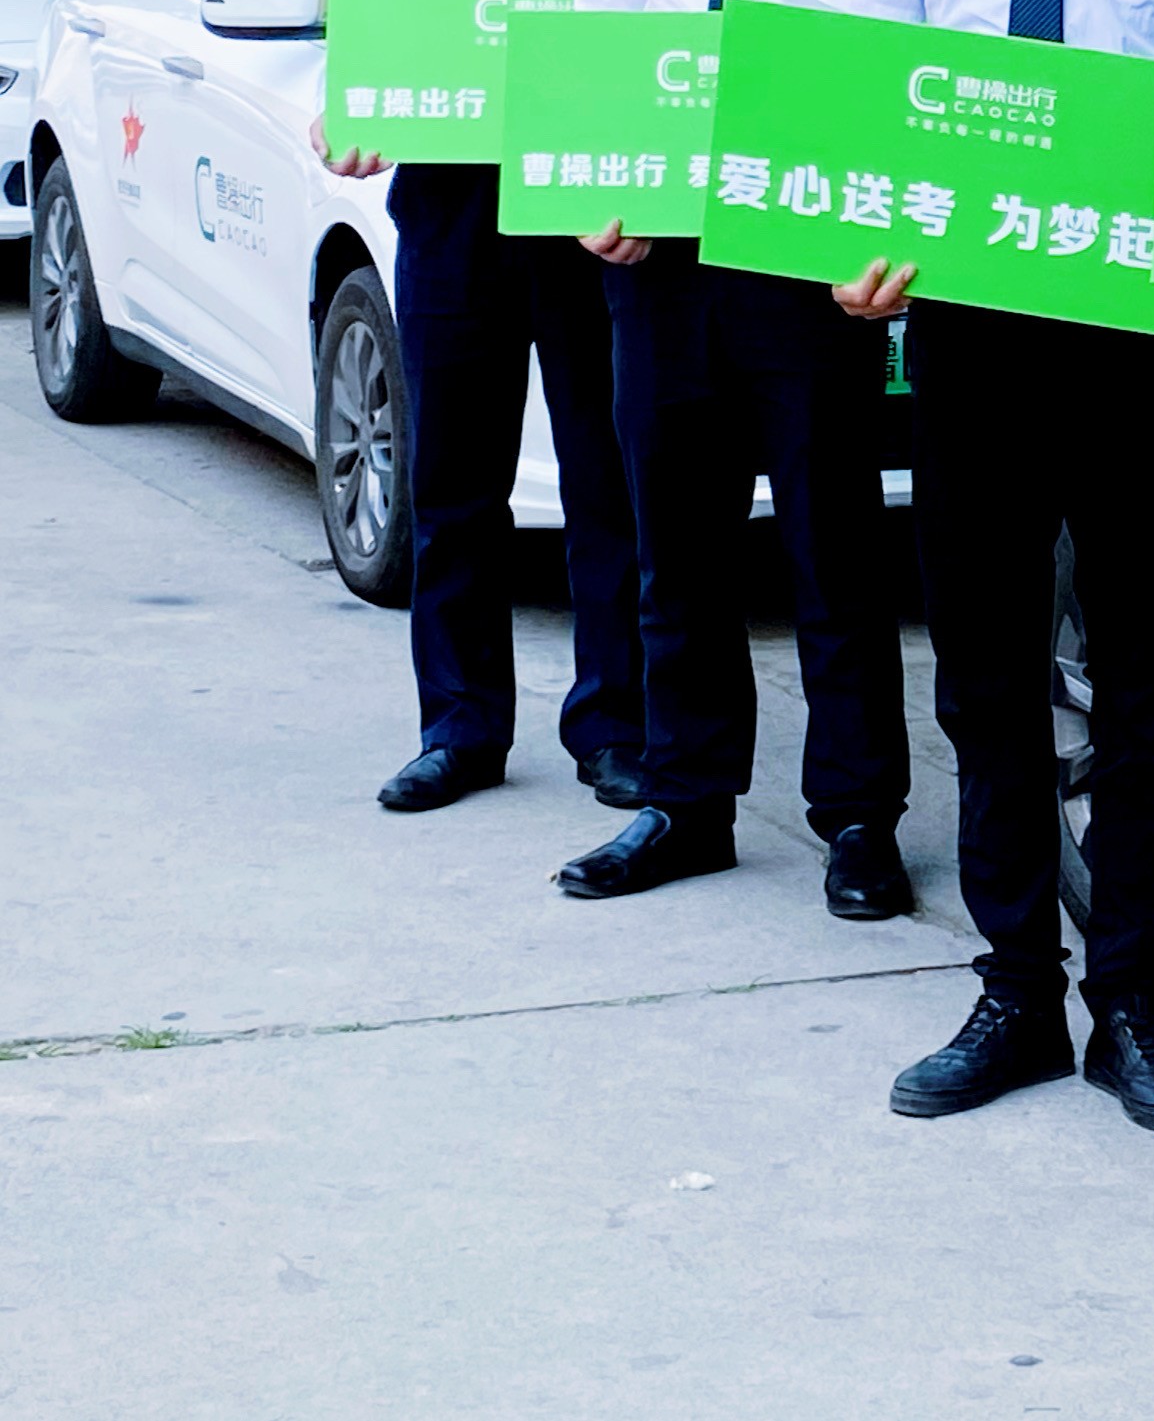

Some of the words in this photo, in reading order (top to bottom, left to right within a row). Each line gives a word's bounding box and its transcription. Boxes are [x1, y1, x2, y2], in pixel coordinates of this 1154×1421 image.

[345, 87, 486, 119] 曹操出行
[956, 76, 1057, 110] 曹操出行
[954, 100, 1055, 127] CAOCAO
[522, 153, 667, 187] 曹操出行
[717, 153, 956, 238] 爱心送考
